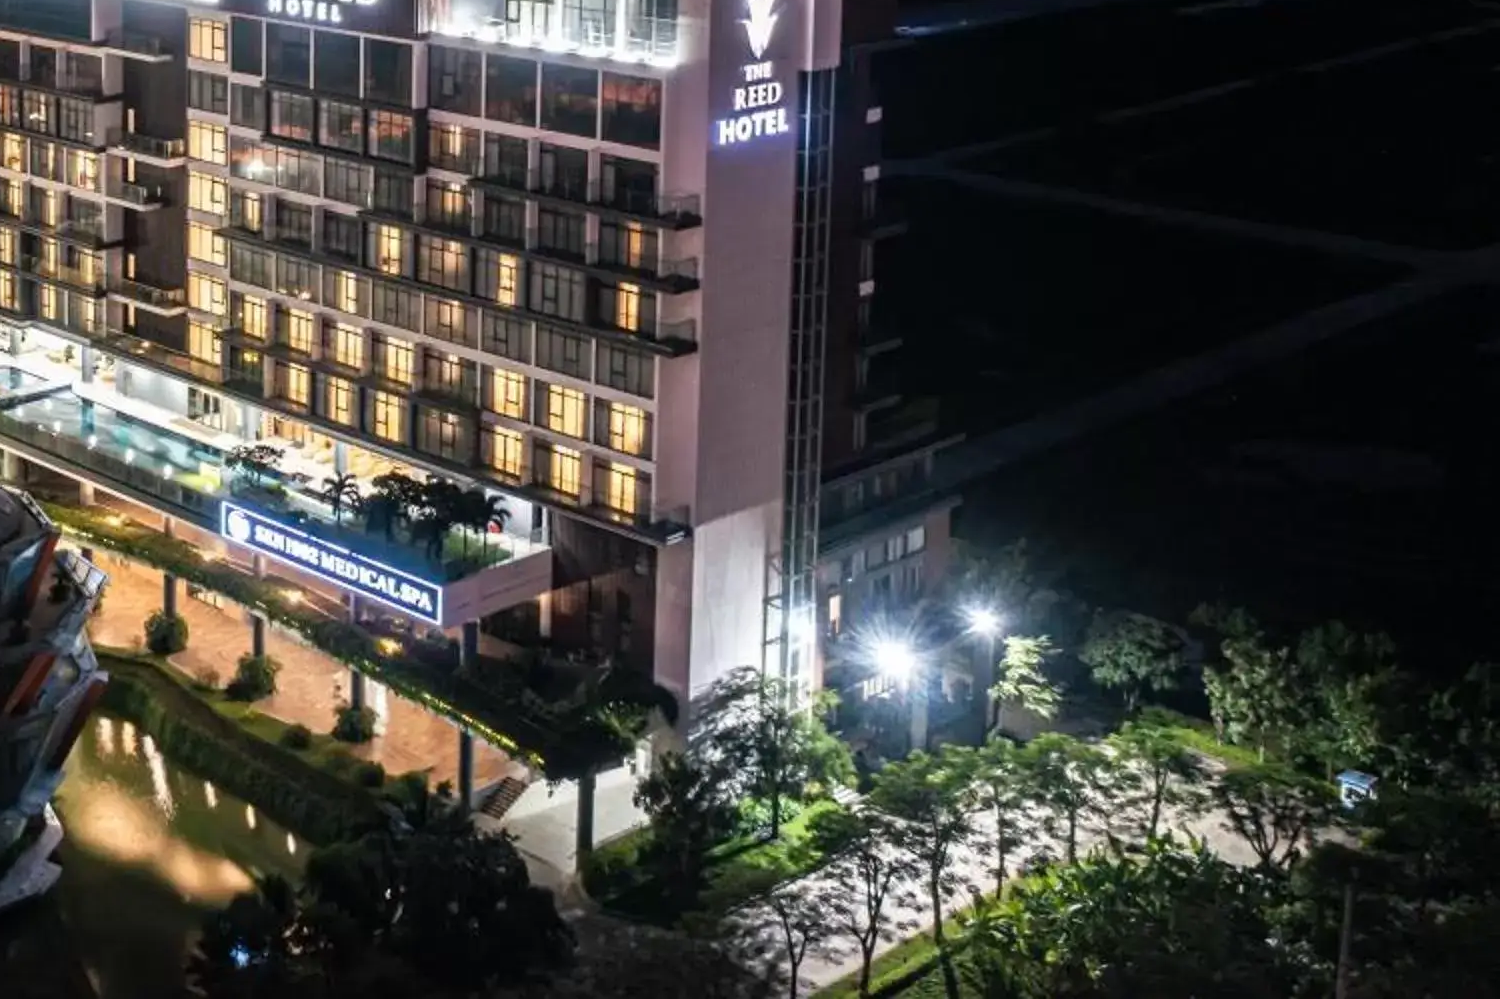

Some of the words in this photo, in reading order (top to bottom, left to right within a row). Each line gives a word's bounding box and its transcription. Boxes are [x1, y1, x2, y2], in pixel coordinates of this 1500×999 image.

[744, 61, 772, 81] THE
[734, 83, 782, 110] REED
[717, 108, 788, 145] HOTEL
[321, 552, 400, 595] MEDICAL
[400, 582, 432, 611] SPA
